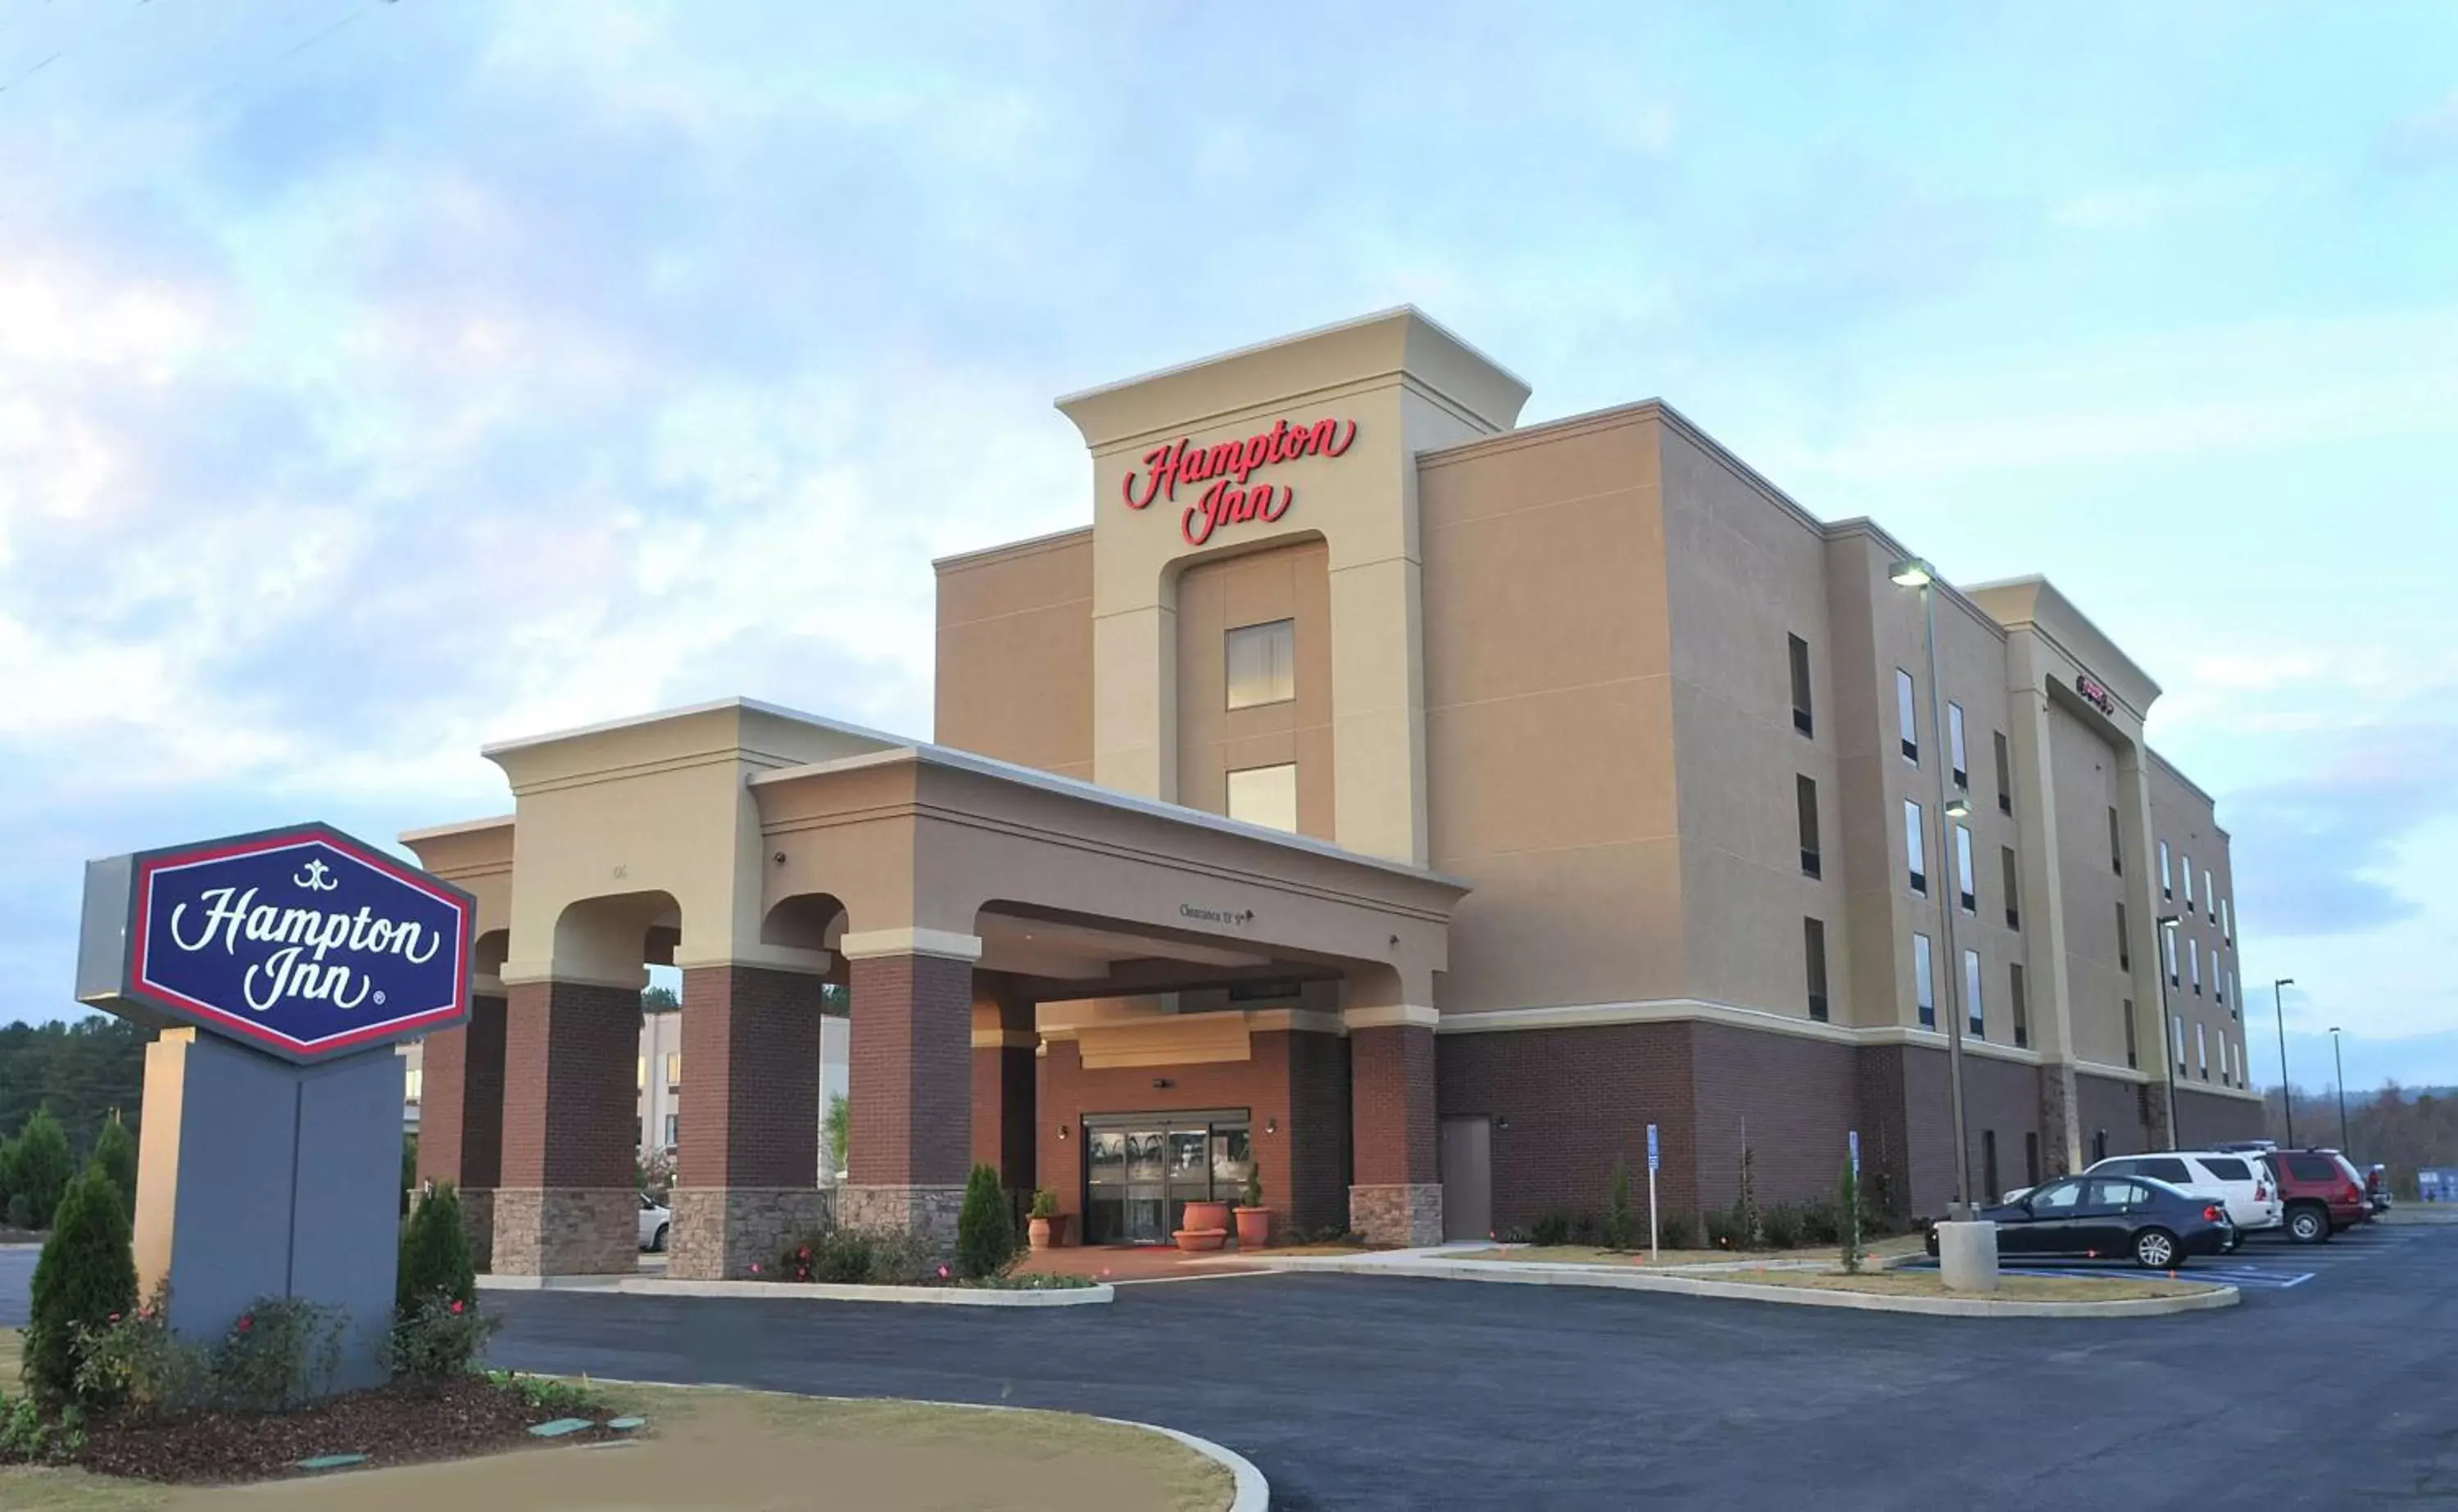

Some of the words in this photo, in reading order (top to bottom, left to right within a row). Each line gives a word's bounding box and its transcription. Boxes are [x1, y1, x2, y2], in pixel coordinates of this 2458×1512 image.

[1122, 419, 1357, 509] Hampton
[1181, 480, 1293, 545] Inn
[170, 886, 441, 964] Hampton
[243, 947, 370, 1012] Inn
